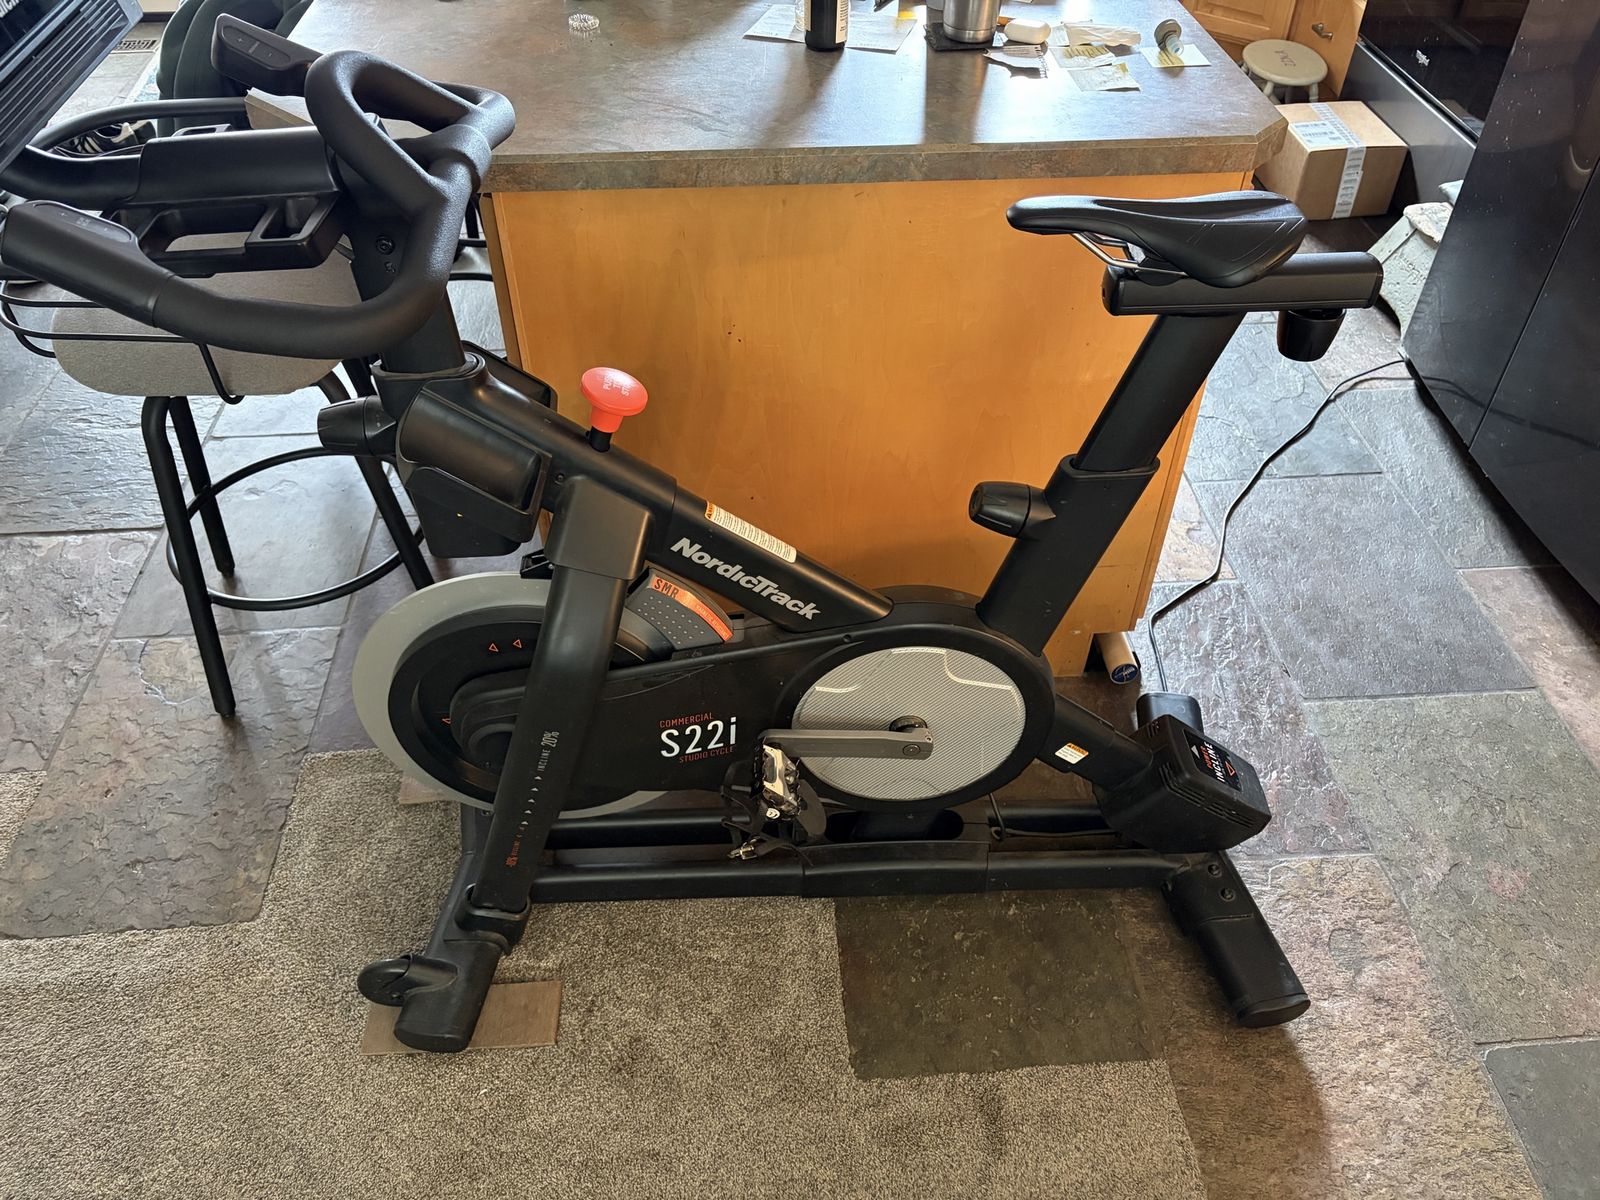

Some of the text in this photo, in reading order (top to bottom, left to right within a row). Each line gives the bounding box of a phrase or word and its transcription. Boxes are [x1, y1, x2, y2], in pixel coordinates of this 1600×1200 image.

[654, 578, 680, 599] SMR
[670, 537, 821, 620] NordicTrack
[660, 712, 714, 728] COMMERCIAL
[660, 716, 737, 758] S22i
[537, 731, 560, 772] INCLINE 20%
[680, 746, 735, 763] STUDIO CYCLE
[1204, 741, 1226, 783] INCLINE
